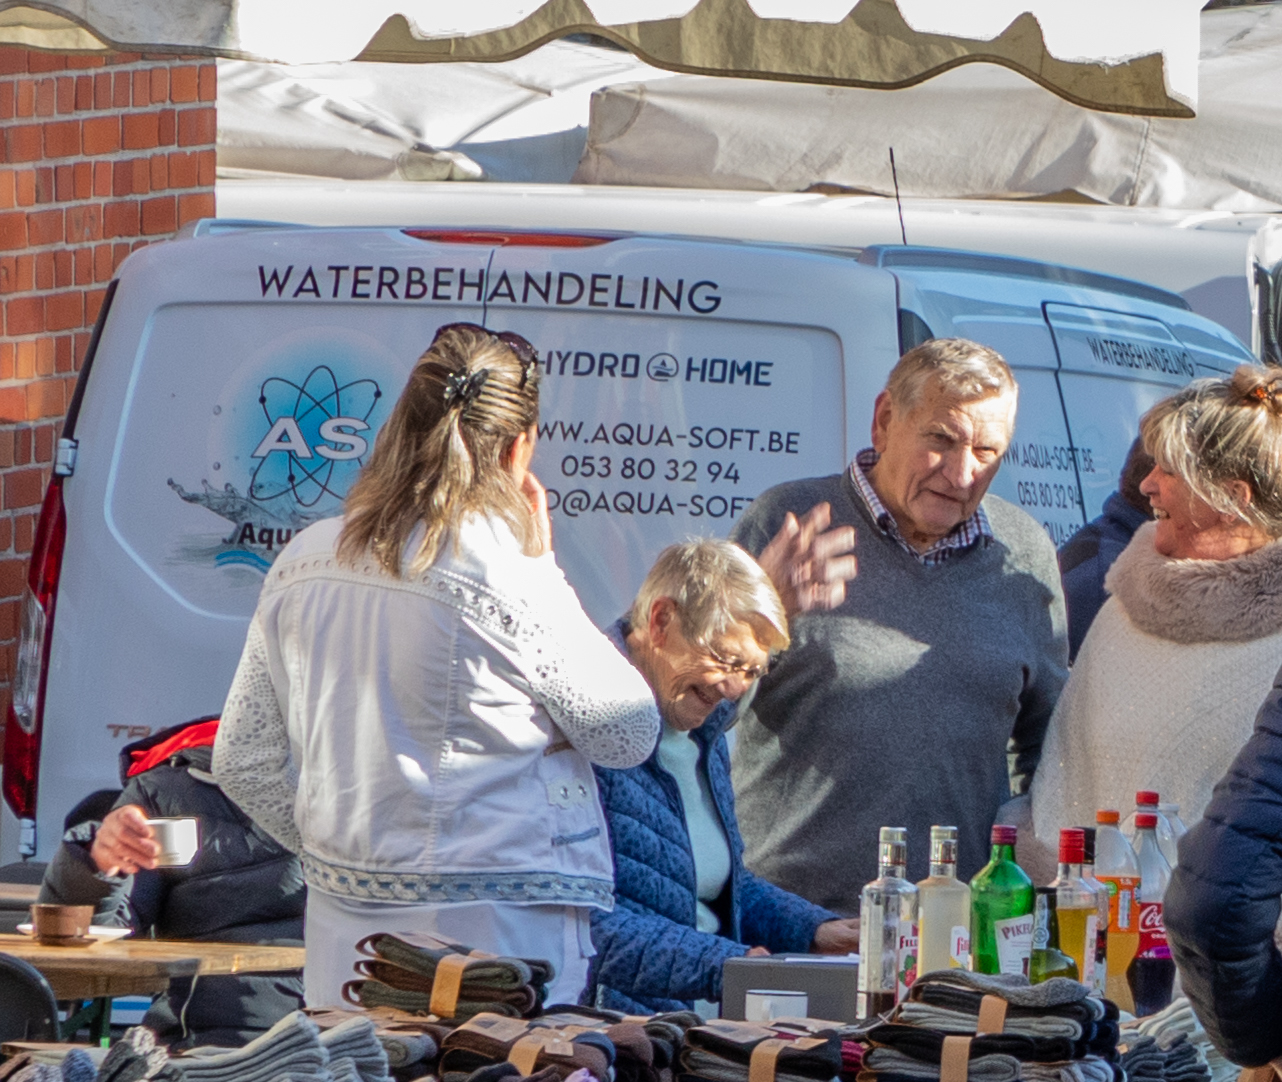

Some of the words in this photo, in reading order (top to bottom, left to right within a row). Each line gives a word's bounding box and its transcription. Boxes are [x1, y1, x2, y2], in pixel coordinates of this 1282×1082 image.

[258, 264, 722, 314] WATERBEHANDELING
[685, 356, 774, 386] HOME
[1086, 336, 1195, 378] WATERBEHANDELING
[251, 416, 371, 460] AS
[537, 420, 800, 454] WW.AQUA-SOFT.BE
[561, 455, 612, 479] 053
[620, 457, 655, 480] 80
[664, 459, 698, 482] 32
[707, 461, 740, 484] 94
[1018, 481, 1038, 506] 053
[1039, 483, 1052, 507] 80
[1054, 484, 1068, 508] 32
[238, 522, 304, 550] Aqu
